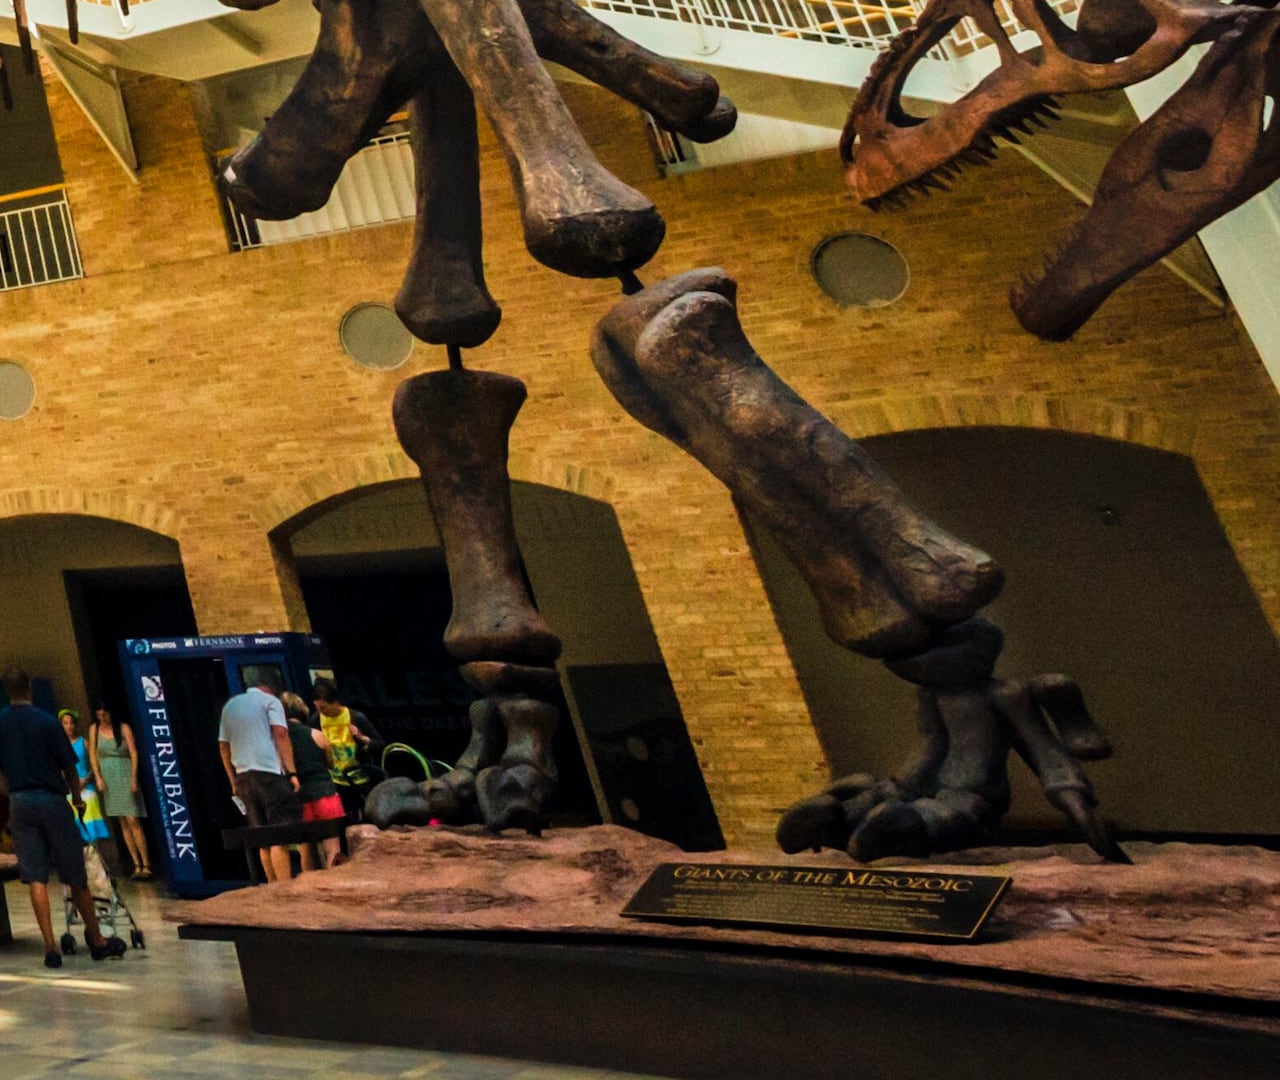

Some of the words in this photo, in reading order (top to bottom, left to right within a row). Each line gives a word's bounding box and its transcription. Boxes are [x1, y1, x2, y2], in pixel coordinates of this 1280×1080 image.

[151, 641, 177, 650] PHOTOS
[193, 636, 245, 647] FERNBANK
[255, 637, 282, 645] PHOTOS
[148, 707, 197, 860] FERNBANK
[673, 864, 753, 881] GIANTS
[756, 870, 788, 883] OF
[791, 872, 839, 886] THE
[842, 871, 974, 893] MESOZOIC
